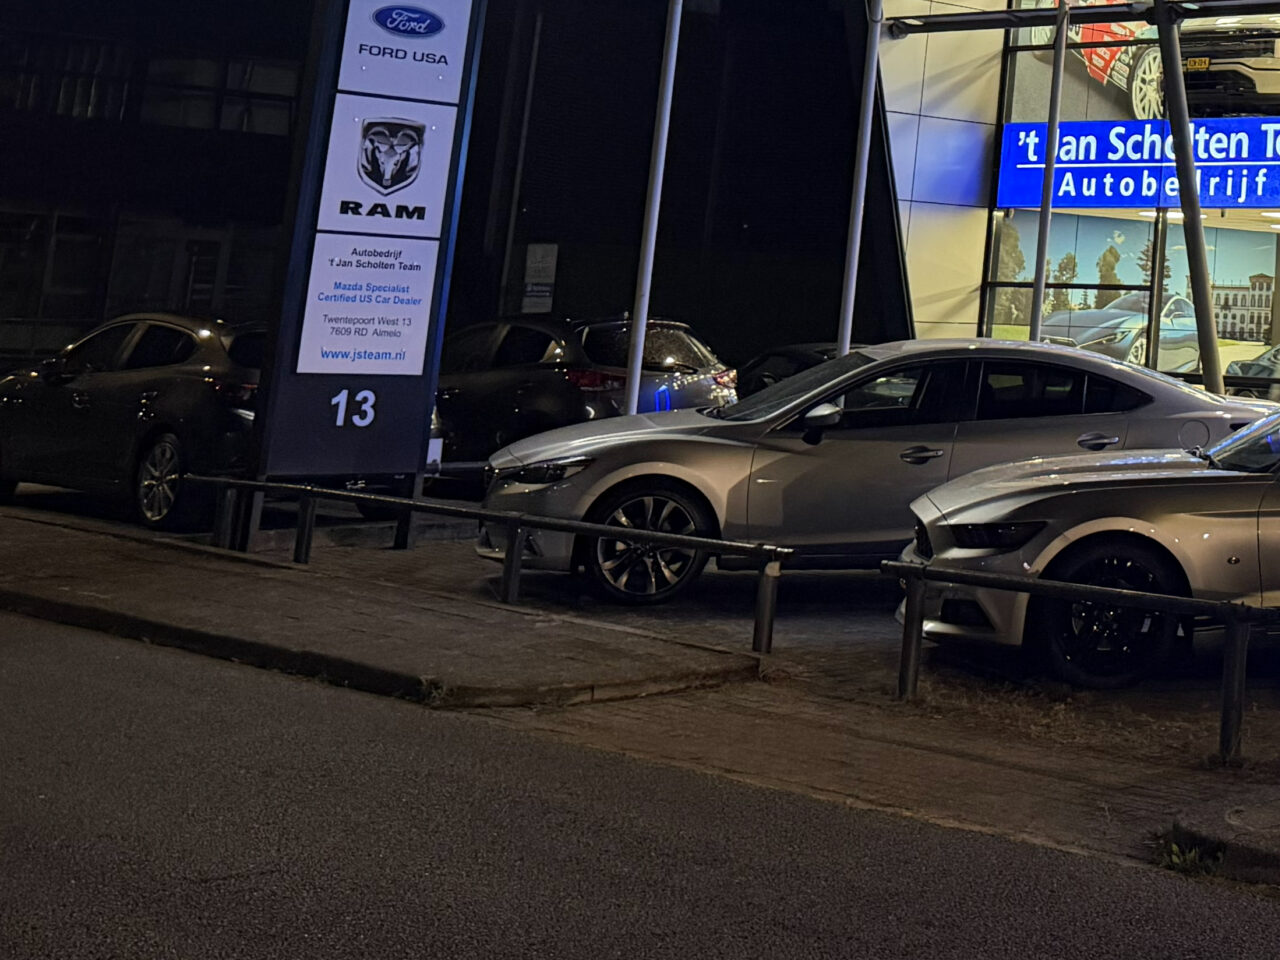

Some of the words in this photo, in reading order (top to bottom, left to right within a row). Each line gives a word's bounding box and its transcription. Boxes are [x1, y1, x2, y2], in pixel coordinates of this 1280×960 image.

[386, 9, 431, 34] Ford
[358, 43, 408, 60] FORD
[412, 51, 449, 66] USA
[1018, 129, 1040, 162] 't
[339, 200, 427, 220] RAM
[351, 248, 402, 260] Autobedrijf
[335, 258, 353, 268] Jan
[355, 259, 395, 270] Scholten
[398, 261, 422, 271] Team
[333, 281, 363, 292] Mazda
[365, 282, 410, 294] Specialist
[317, 292, 357, 303] Certified
[359, 294, 373, 304] US
[374, 295, 391, 305] Car
[393, 296, 422, 306] Dealer
[323, 314, 375, 326] Twentepoort
[377, 316, 399, 326] West
[402, 317, 412, 326] 13
[330, 326, 352, 336] 7609
[353, 327, 368, 337] RD
[372, 328, 402, 338] Almelo
[320, 347, 407, 362] www.jsteam.nl
[330, 389, 377, 428] 13
